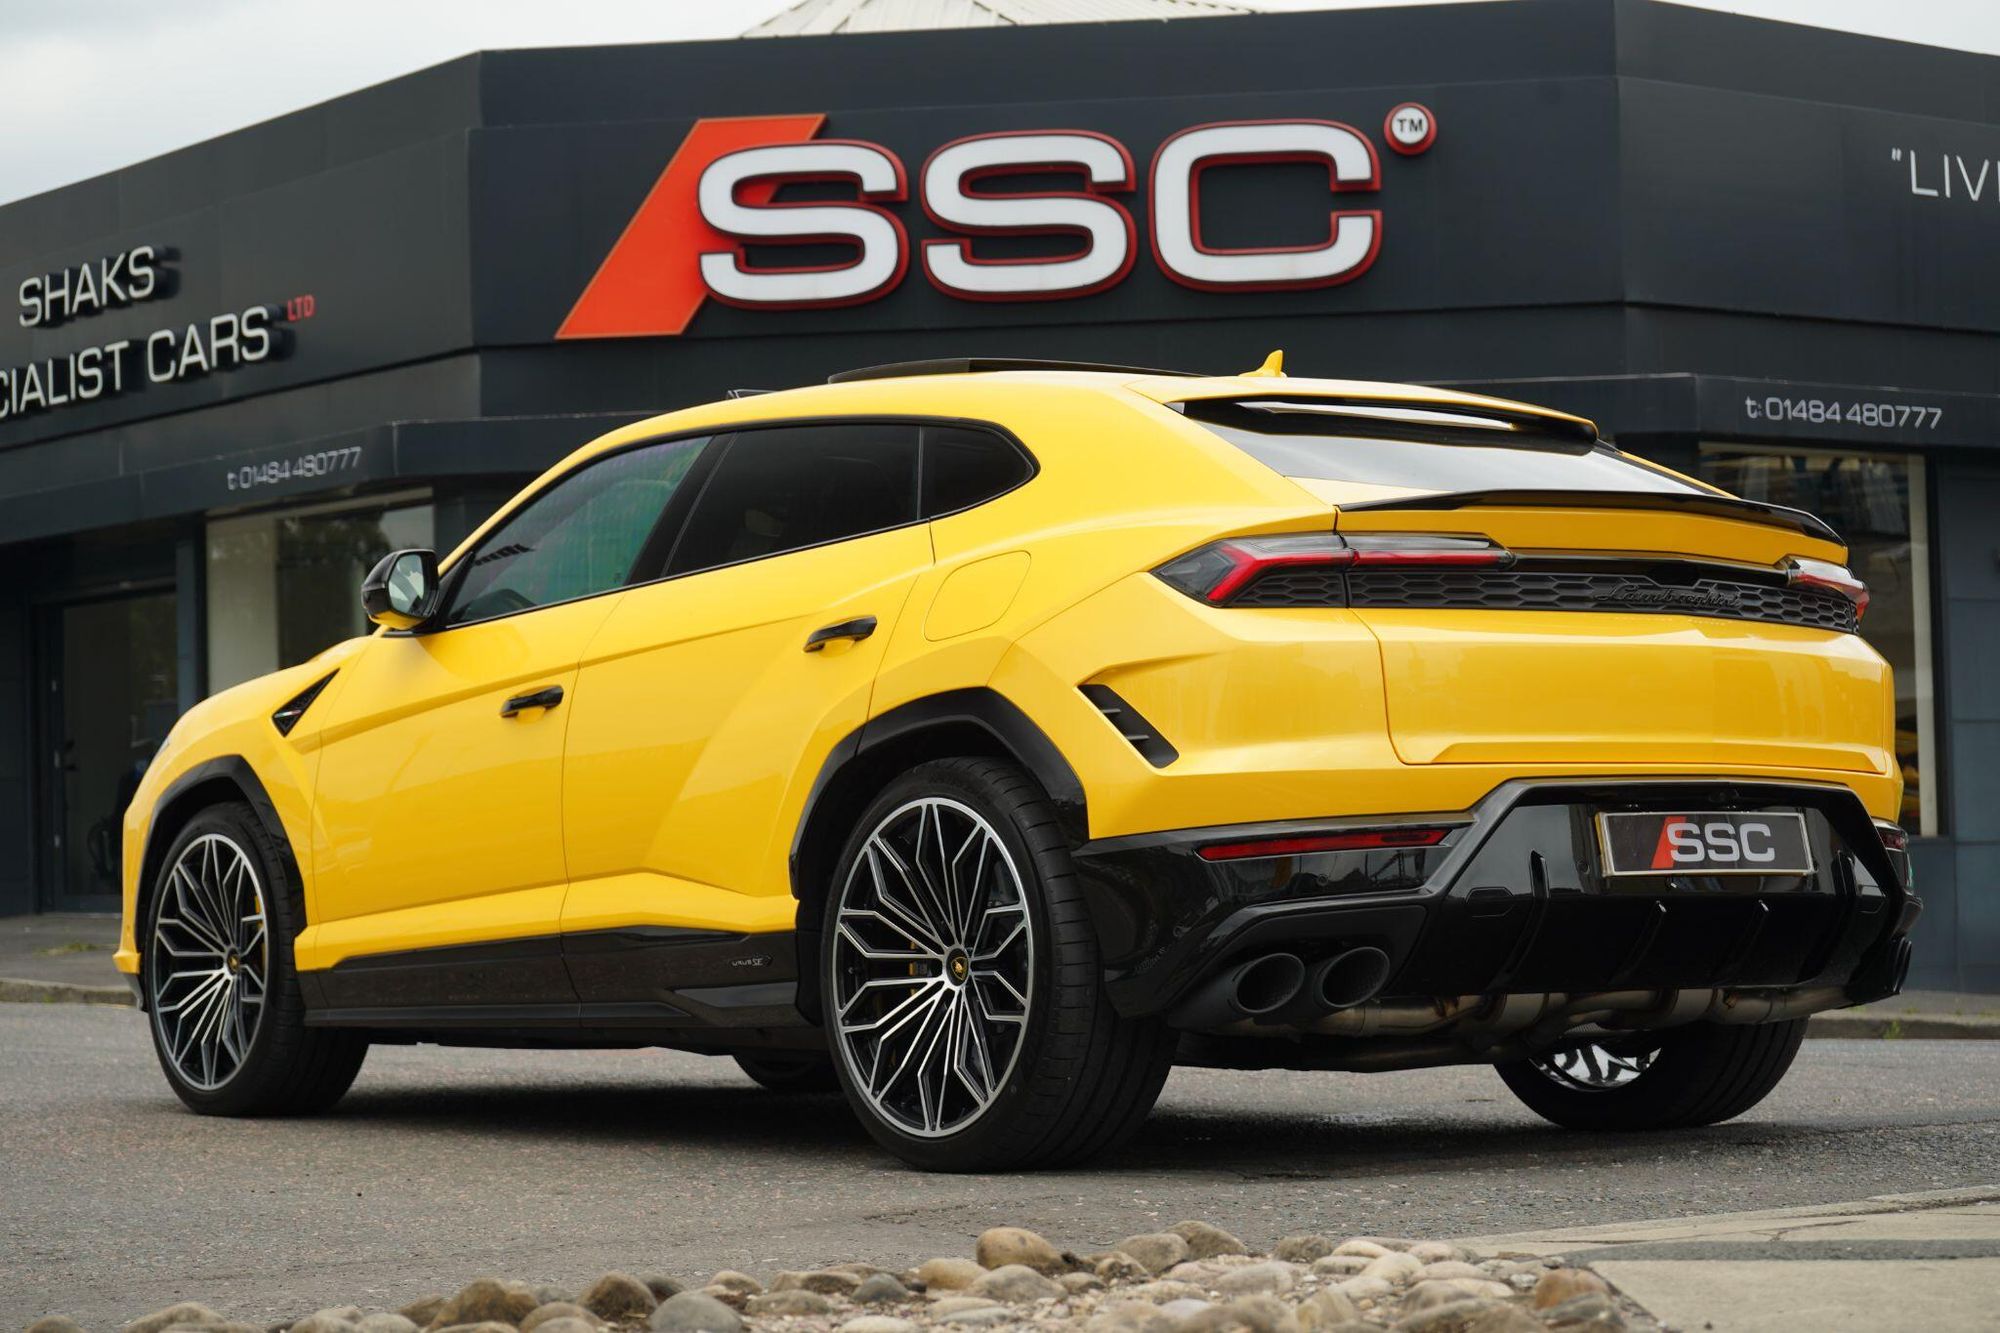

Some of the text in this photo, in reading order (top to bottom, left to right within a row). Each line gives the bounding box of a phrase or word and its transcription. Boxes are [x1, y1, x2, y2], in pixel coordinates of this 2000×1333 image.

[1891, 147, 2000, 203] "LIV
[697, 118, 1423, 310] SSC TM
[18, 245, 155, 327] SHAKS
[147, 305, 271, 383] CARS
[287, 294, 316, 321] LTD
[1846, 403, 1943, 429] 480777
[1666, 822, 1776, 863] SSC
